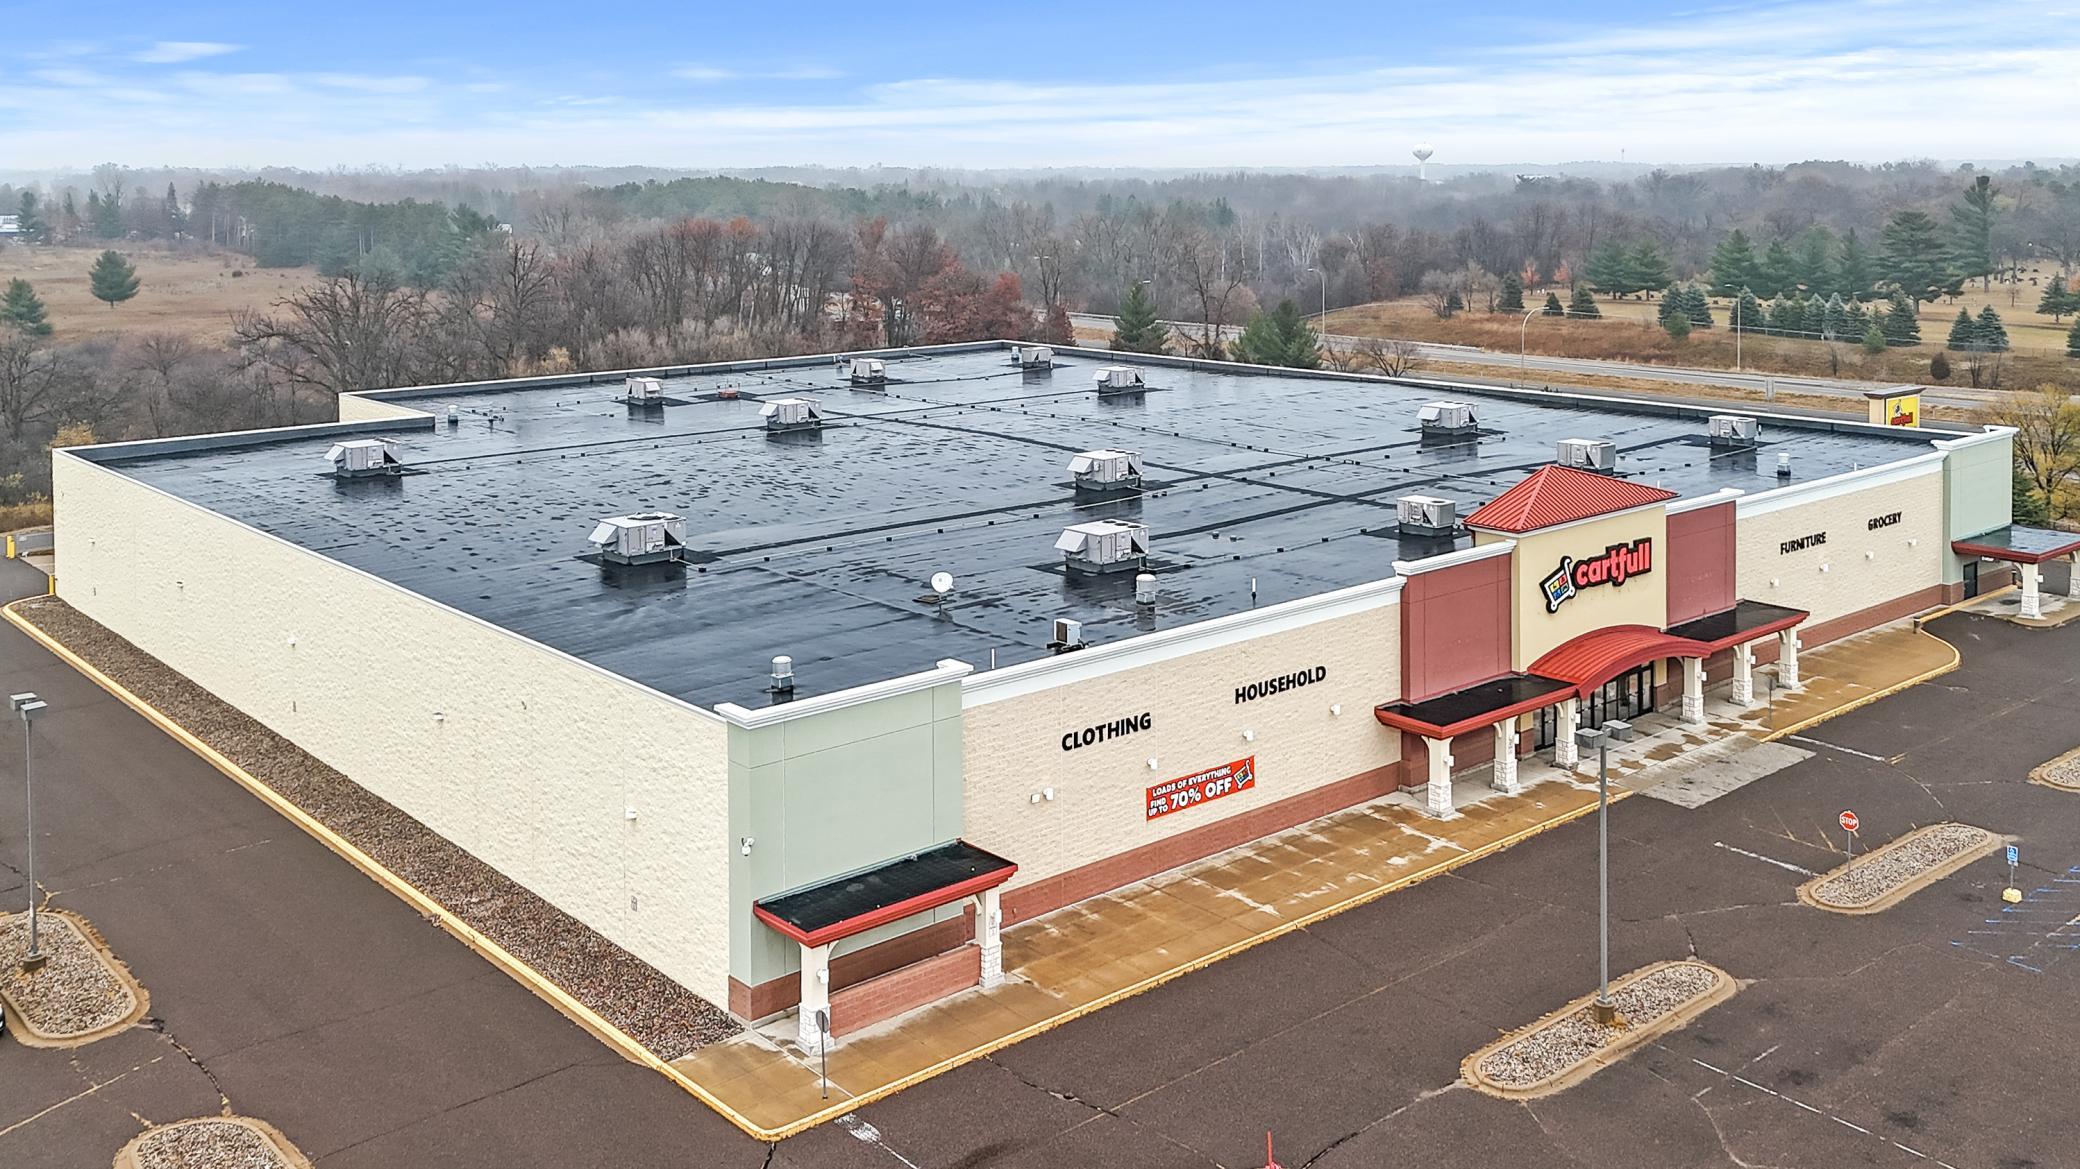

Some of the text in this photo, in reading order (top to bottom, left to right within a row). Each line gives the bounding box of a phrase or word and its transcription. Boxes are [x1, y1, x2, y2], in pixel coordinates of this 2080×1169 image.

[1867, 511, 1902, 531] GROCERY
[1780, 532, 1826, 555] FURNITURE
[1575, 540, 1651, 586] cartfull
[1234, 665, 1327, 704] HOUSEHOLD
[1061, 712, 1152, 751] CLOTHING
[1152, 766, 1232, 797] LOADS OF EVERYTHING
[1170, 776, 1233, 810] 70% OFF
[1148, 805, 1169, 817] UP TO
[1150, 797, 1167, 808] FIND
[1841, 816, 1858, 826] STOP
